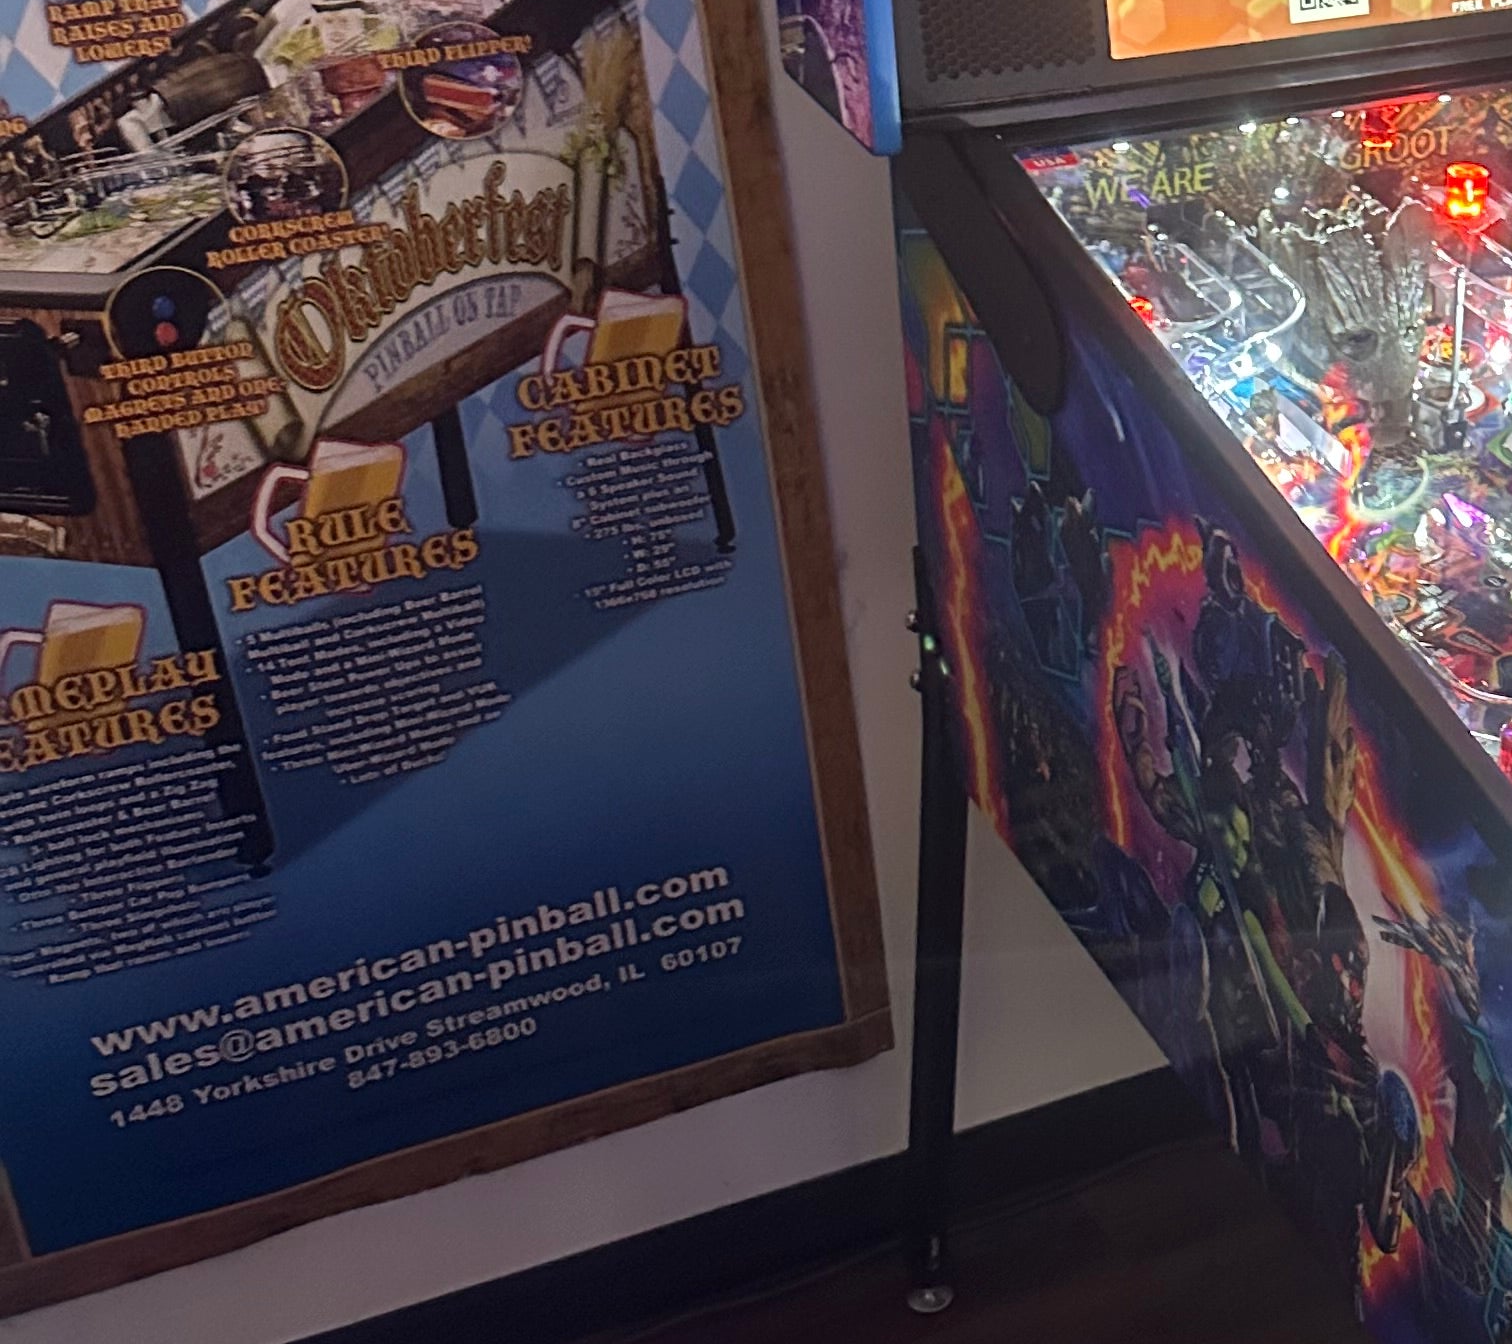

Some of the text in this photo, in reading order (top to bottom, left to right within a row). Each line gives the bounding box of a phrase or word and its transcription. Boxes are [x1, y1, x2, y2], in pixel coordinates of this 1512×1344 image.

[49, 0, 115, 23] RAMP
[1451, 0, 1484, 13] FREE
[53, 12, 185, 44] RAISES AND
[76, 36, 172, 62] LOWERS!
[444, 35, 532, 60] FLIPPER!
[1032, 156, 1064, 170] USA
[1339, 127, 1454, 170] GROOT
[1085, 161, 1215, 208] WE ARE
[229, 210, 354, 244] CORKSCREW
[206, 241, 286, 268] ROLLER
[363, 283, 523, 393] PINBALL ON TAP
[101, 355, 167, 379] THIRD
[128, 366, 237, 395] CONTROLS
[518, 346, 721, 410] CABINET
[192, 384, 235, 404] AND
[509, 386, 745, 460] FEATURES
[285, 499, 411, 555] RULE
[228, 528, 479, 612] FEATURES
[0, 649, 221, 725] MEPLAY
[91, 866, 729, 1056] www.american-pinball.com
[90, 898, 744, 1096] sales@american-pinball.com
[111, 936, 742, 1128] 1448 Yorkshire Drive Streamwood, IL 60107
